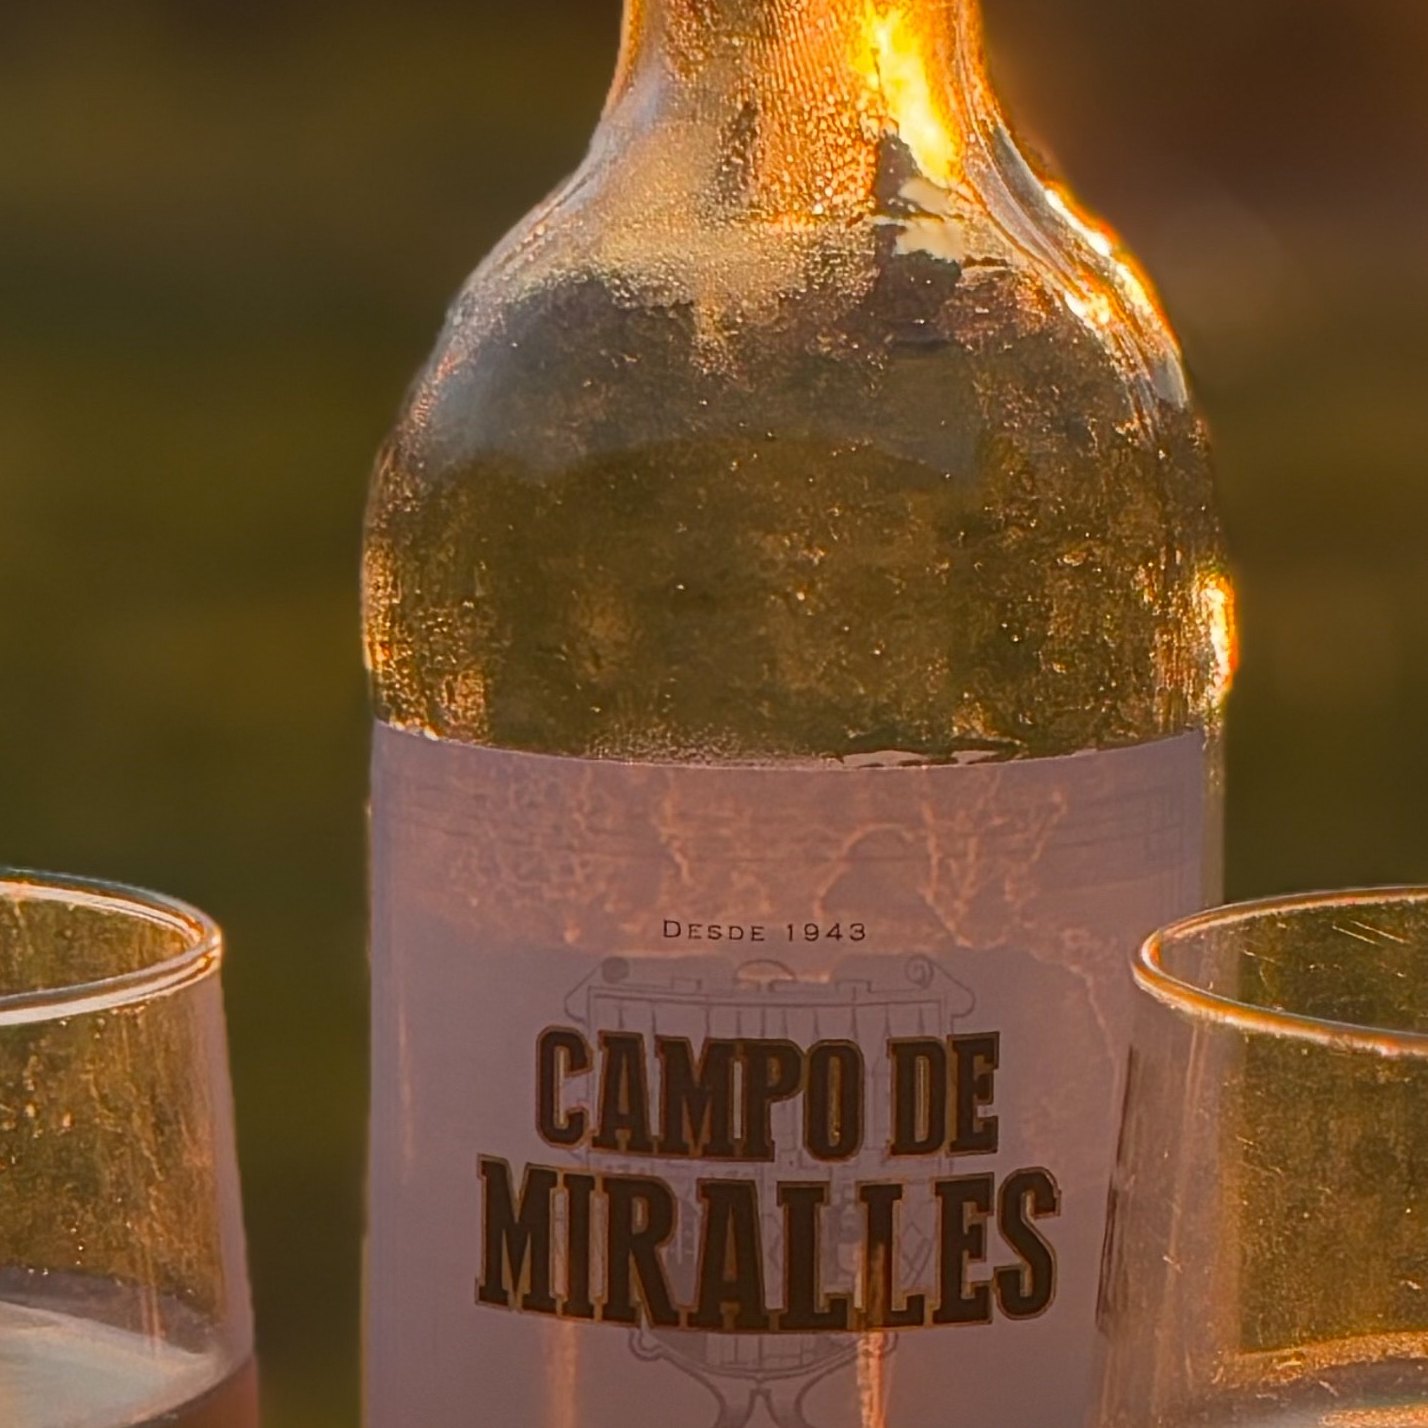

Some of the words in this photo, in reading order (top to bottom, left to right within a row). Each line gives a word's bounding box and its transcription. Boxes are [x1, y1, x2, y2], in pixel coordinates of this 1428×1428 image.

[662, 919, 766, 943] DESDE
[786, 922, 866, 942] 1943
[534, 1025, 866, 1162] CAMPO
[885, 1030, 1001, 1156] DE
[475, 1153, 1061, 1332] MIRALLES
